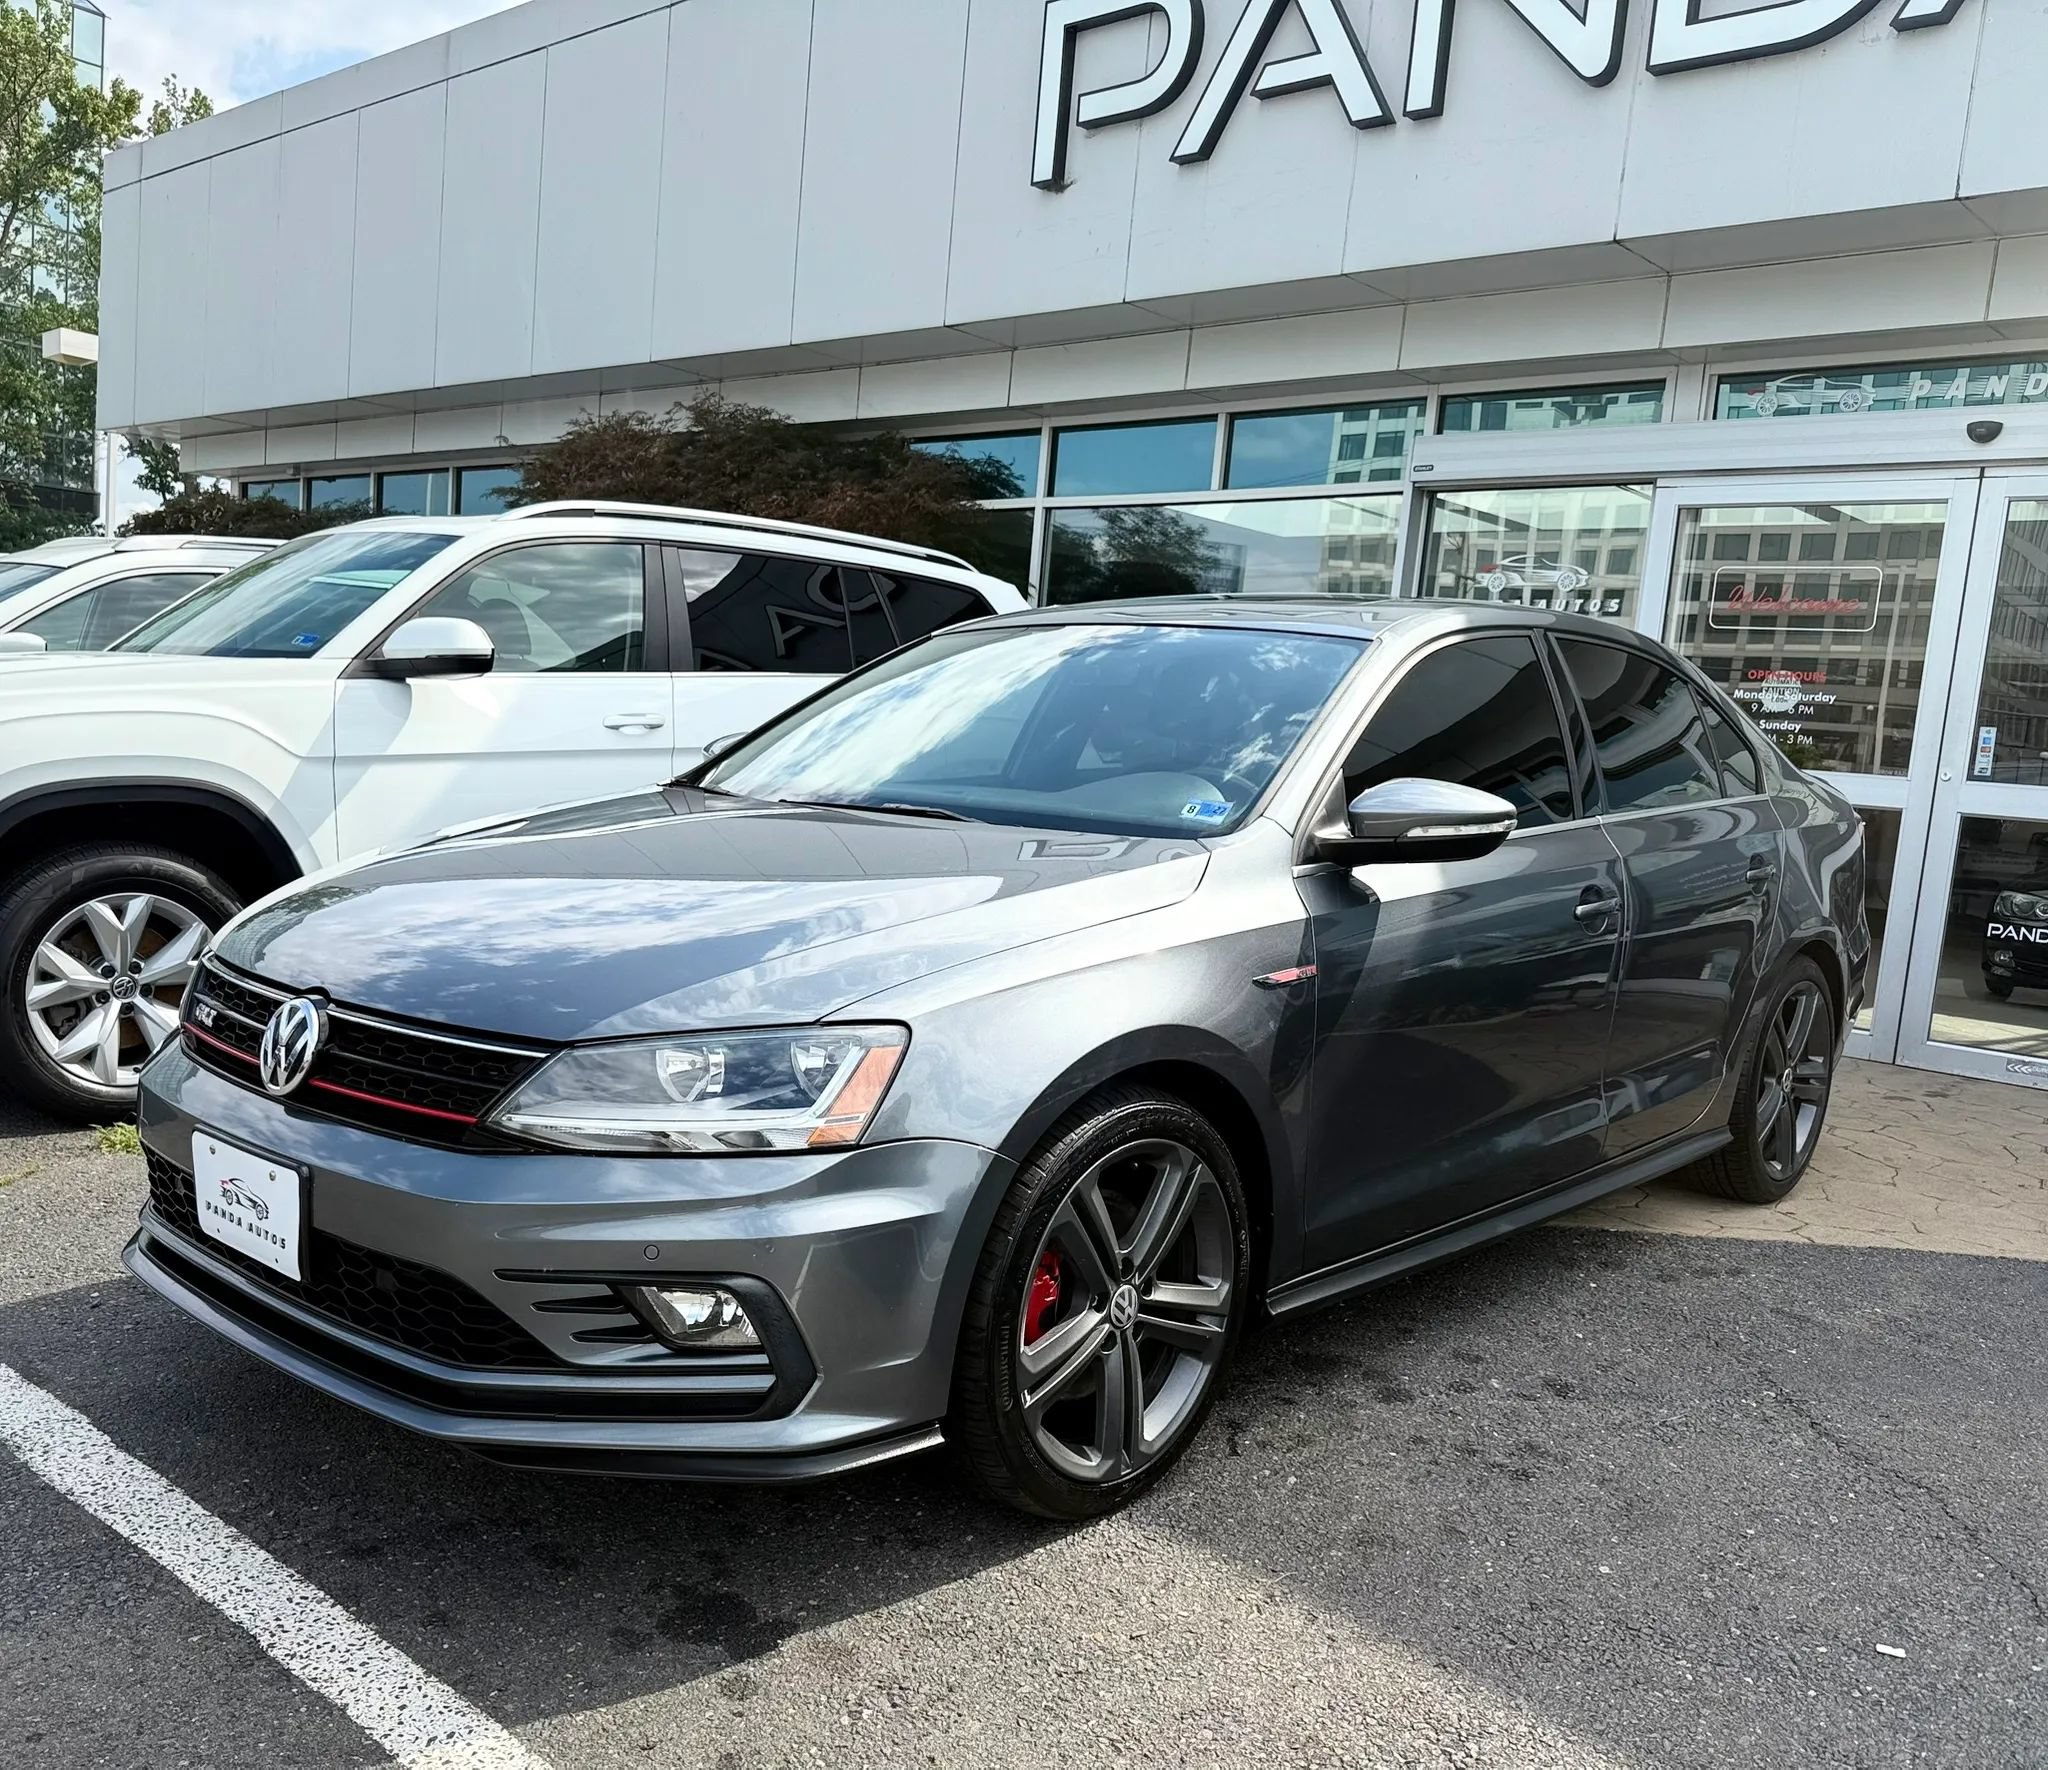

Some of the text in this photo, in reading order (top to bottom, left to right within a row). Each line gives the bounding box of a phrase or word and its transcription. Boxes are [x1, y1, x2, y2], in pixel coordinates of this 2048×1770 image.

[1031, 0, 1978, 192] PAN
[1538, 599, 1620, 612] AUTOS
[1733, 689, 1837, 704] Monday-Saturday
[1751, 703, 1758, 712] 9
[1798, 705, 1814, 715] PM
[1759, 719, 1802, 733] Sunday
[1787, 734, 1794, 744] 3
[1797, 735, 1813, 745] PM
[1187, 805, 1196, 814] 8
[205, 1200, 286, 1249] PANDA AUTOS
